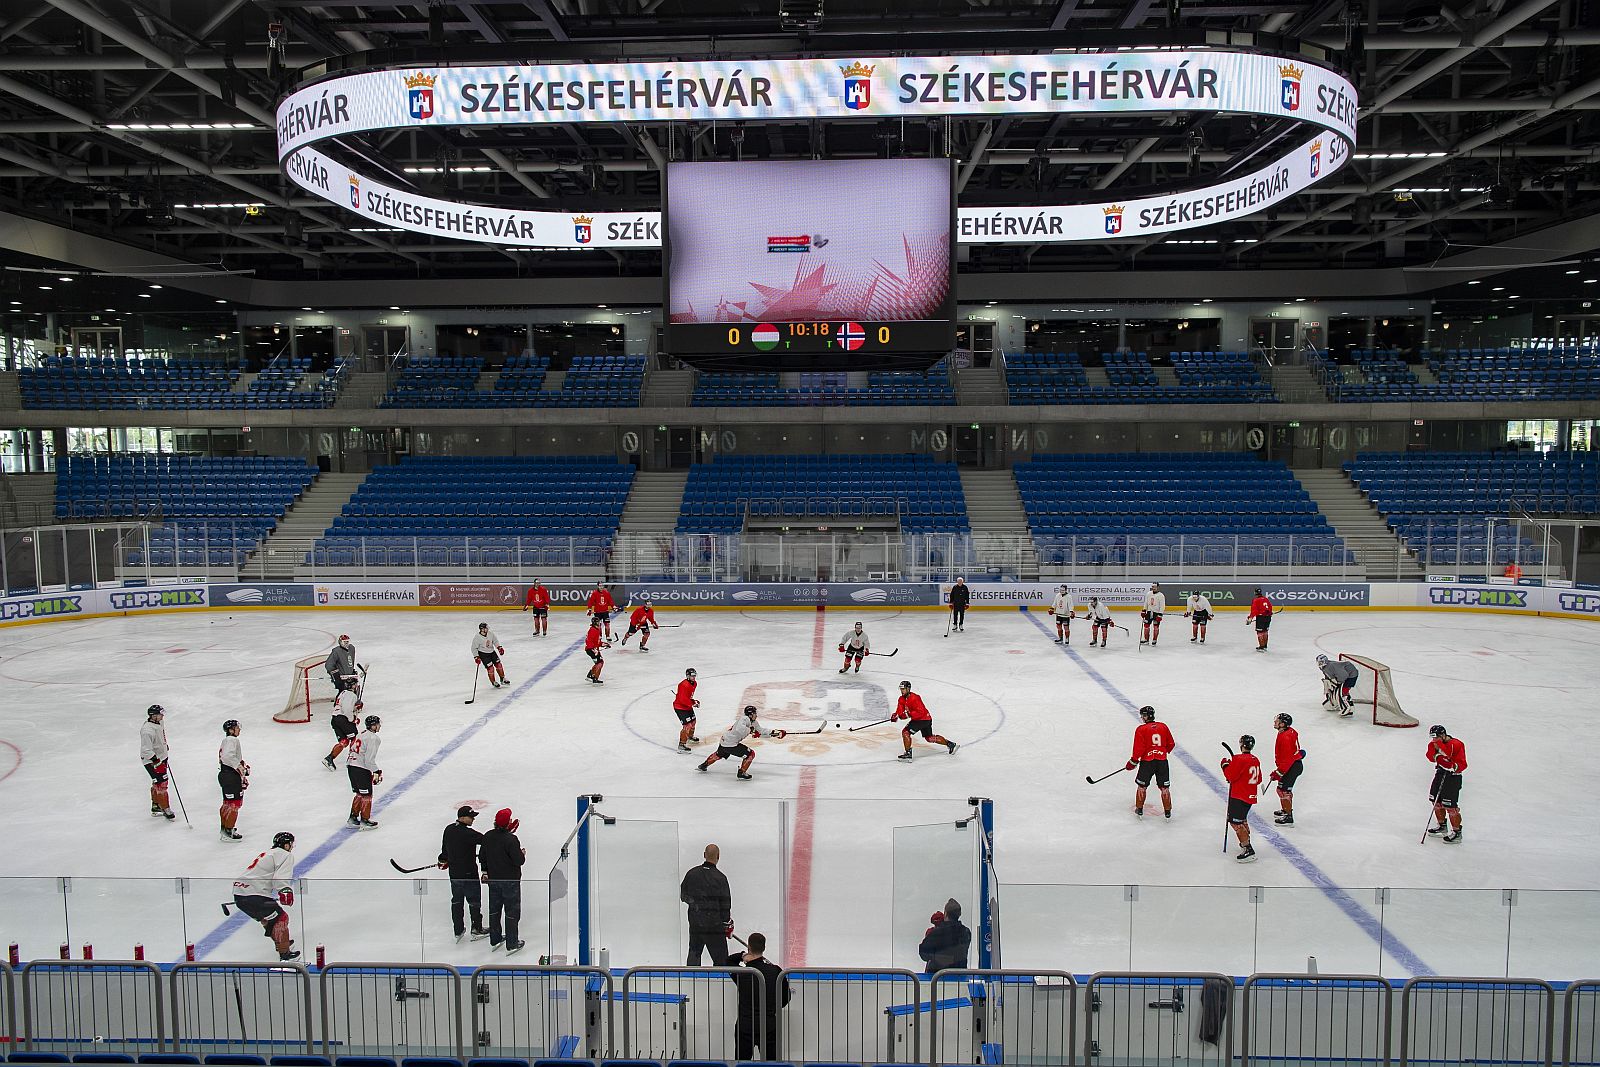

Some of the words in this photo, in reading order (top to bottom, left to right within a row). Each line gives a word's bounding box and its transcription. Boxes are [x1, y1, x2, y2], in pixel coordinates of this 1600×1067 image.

[899, 60, 1218, 103] SZÉKESFEHÉRVÁR
[461, 69, 773, 113] SZÉKESFEHÉRVÁR
[1317, 84, 1357, 133] SZÉKE
[1139, 167, 1289, 227] SZÉKESFEHÉRVÁR
[366, 190, 535, 239] SZÉKESFEHÉRVÁR
[957, 212, 1063, 236] EHÉRVÁR
[728, 328, 740, 345] 0
[789, 323, 829, 336] 10:18
[878, 326, 890, 344] 0
[333, 588, 415, 600] SZÉKESFEHÉRVÁR
[629, 589, 725, 600] KÖSZÖNJÜK!
[1179, 591, 1235, 600] SODA
[1265, 589, 1365, 600] KÖSZÖNJÜK!
[1151, 733, 1162, 747] 9
